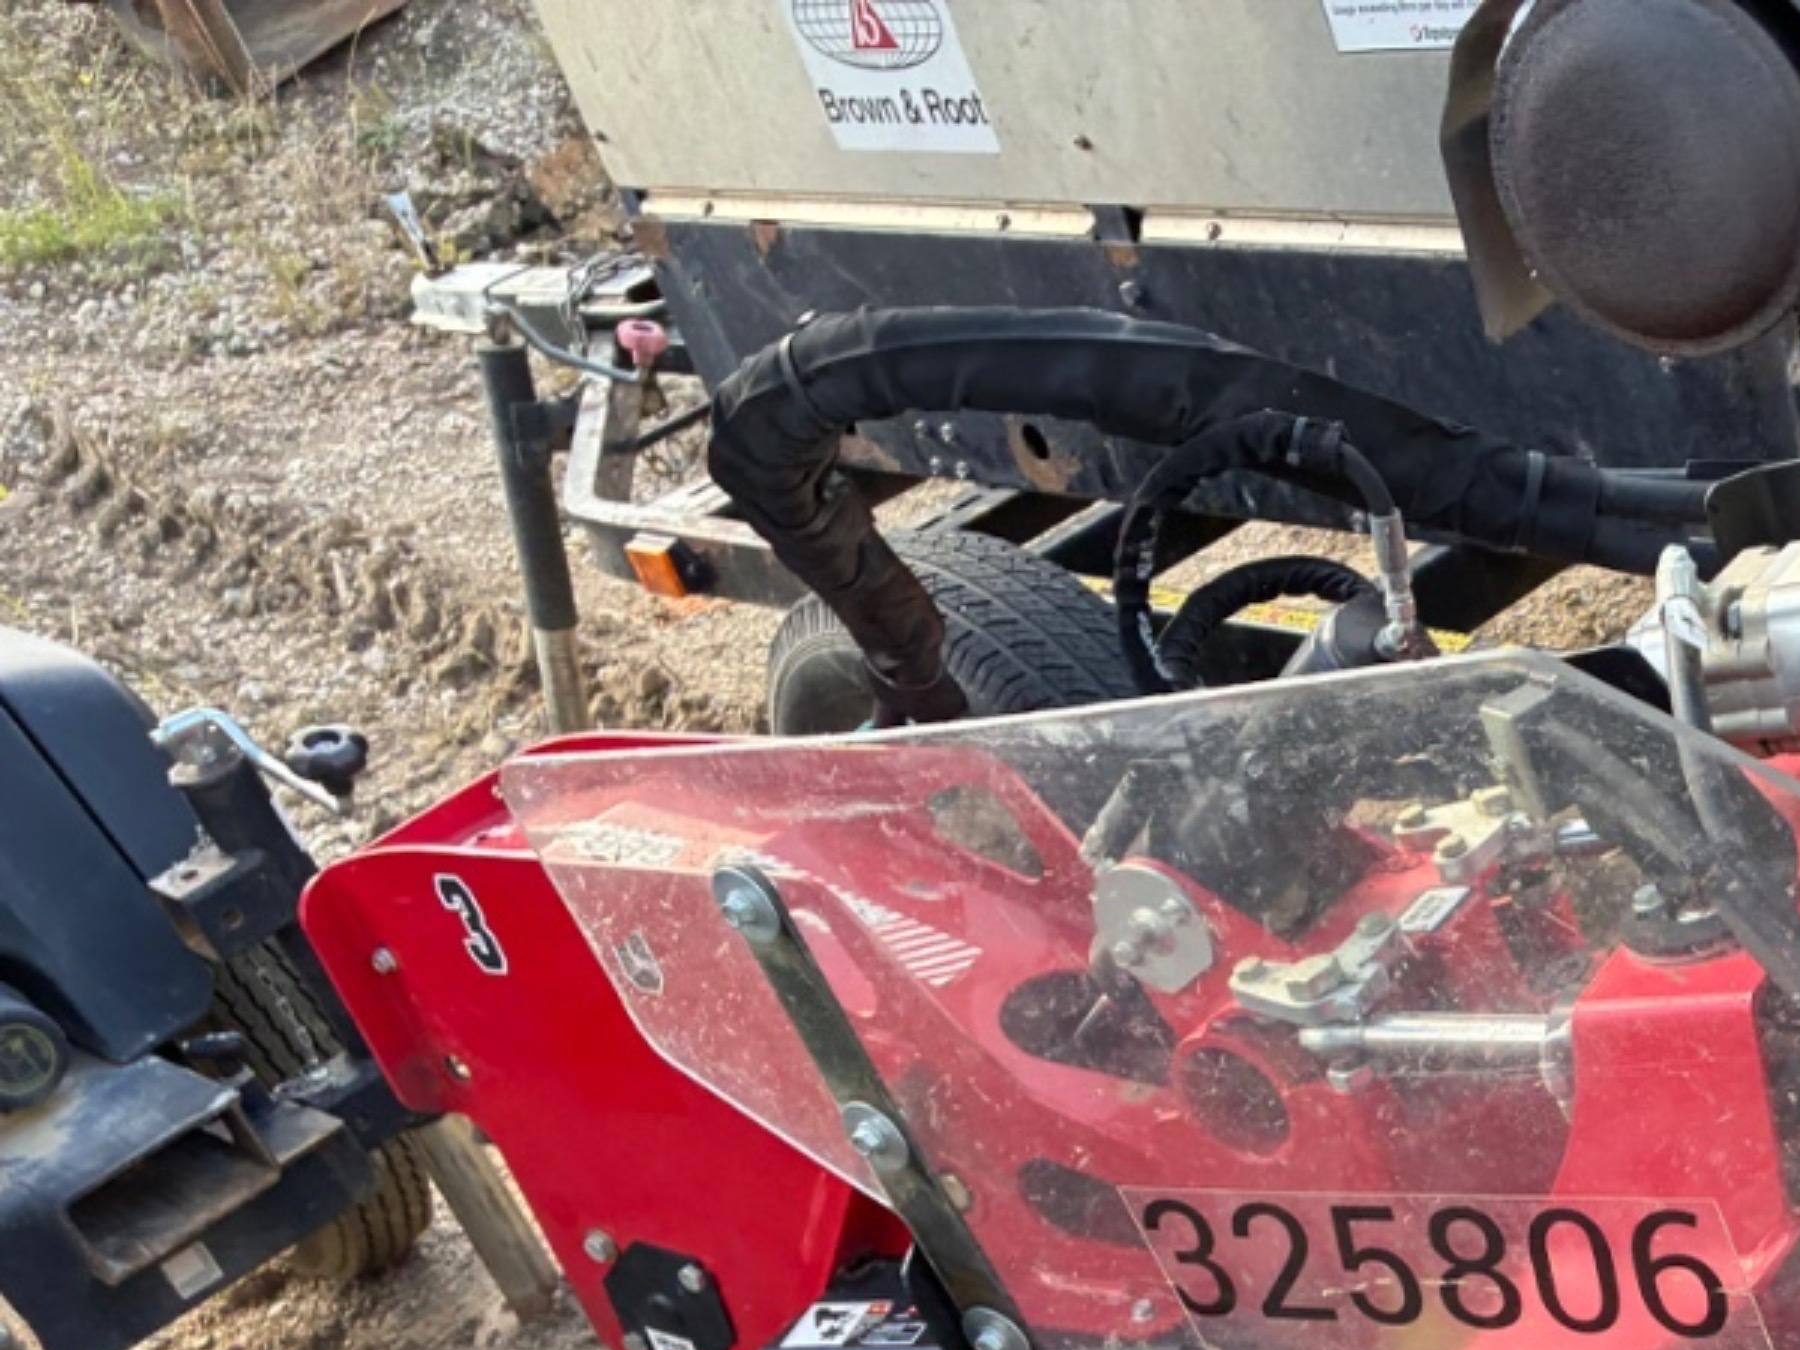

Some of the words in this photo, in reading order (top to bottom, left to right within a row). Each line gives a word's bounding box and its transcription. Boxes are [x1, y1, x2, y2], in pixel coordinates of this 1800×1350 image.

[818, 87, 900, 124] Brown
[900, 87, 922, 124] &
[921, 87, 990, 125] Root
[436, 874, 506, 974] 3
[1141, 1200, 1729, 1338] 325806
